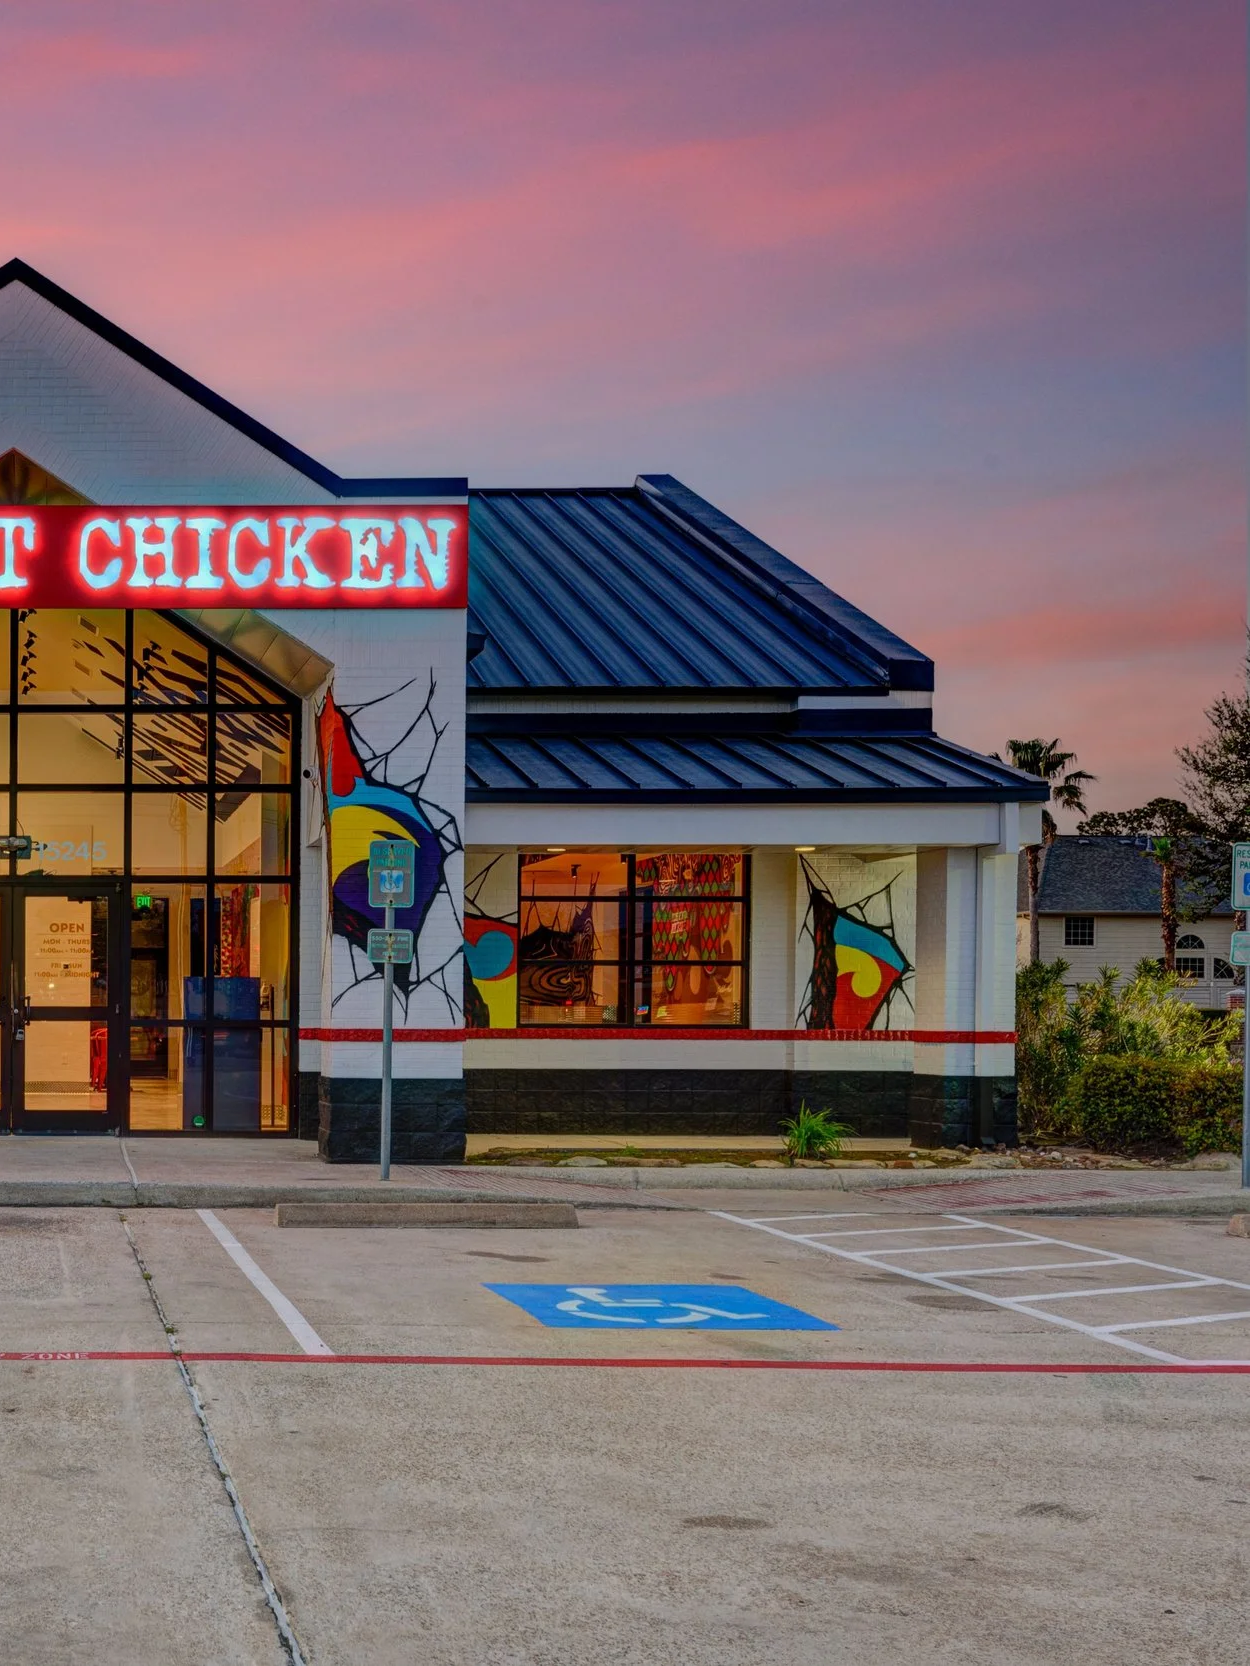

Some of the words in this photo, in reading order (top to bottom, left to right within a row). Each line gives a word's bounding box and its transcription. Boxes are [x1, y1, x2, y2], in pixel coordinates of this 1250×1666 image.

[78, 515, 457, 591] CHICKEN
[38, 841, 107, 862] 15245
[136, 896, 151, 908] EXIT
[49, 922, 85, 933] OPEN
[21, 1352, 91, 1361] ZONE
